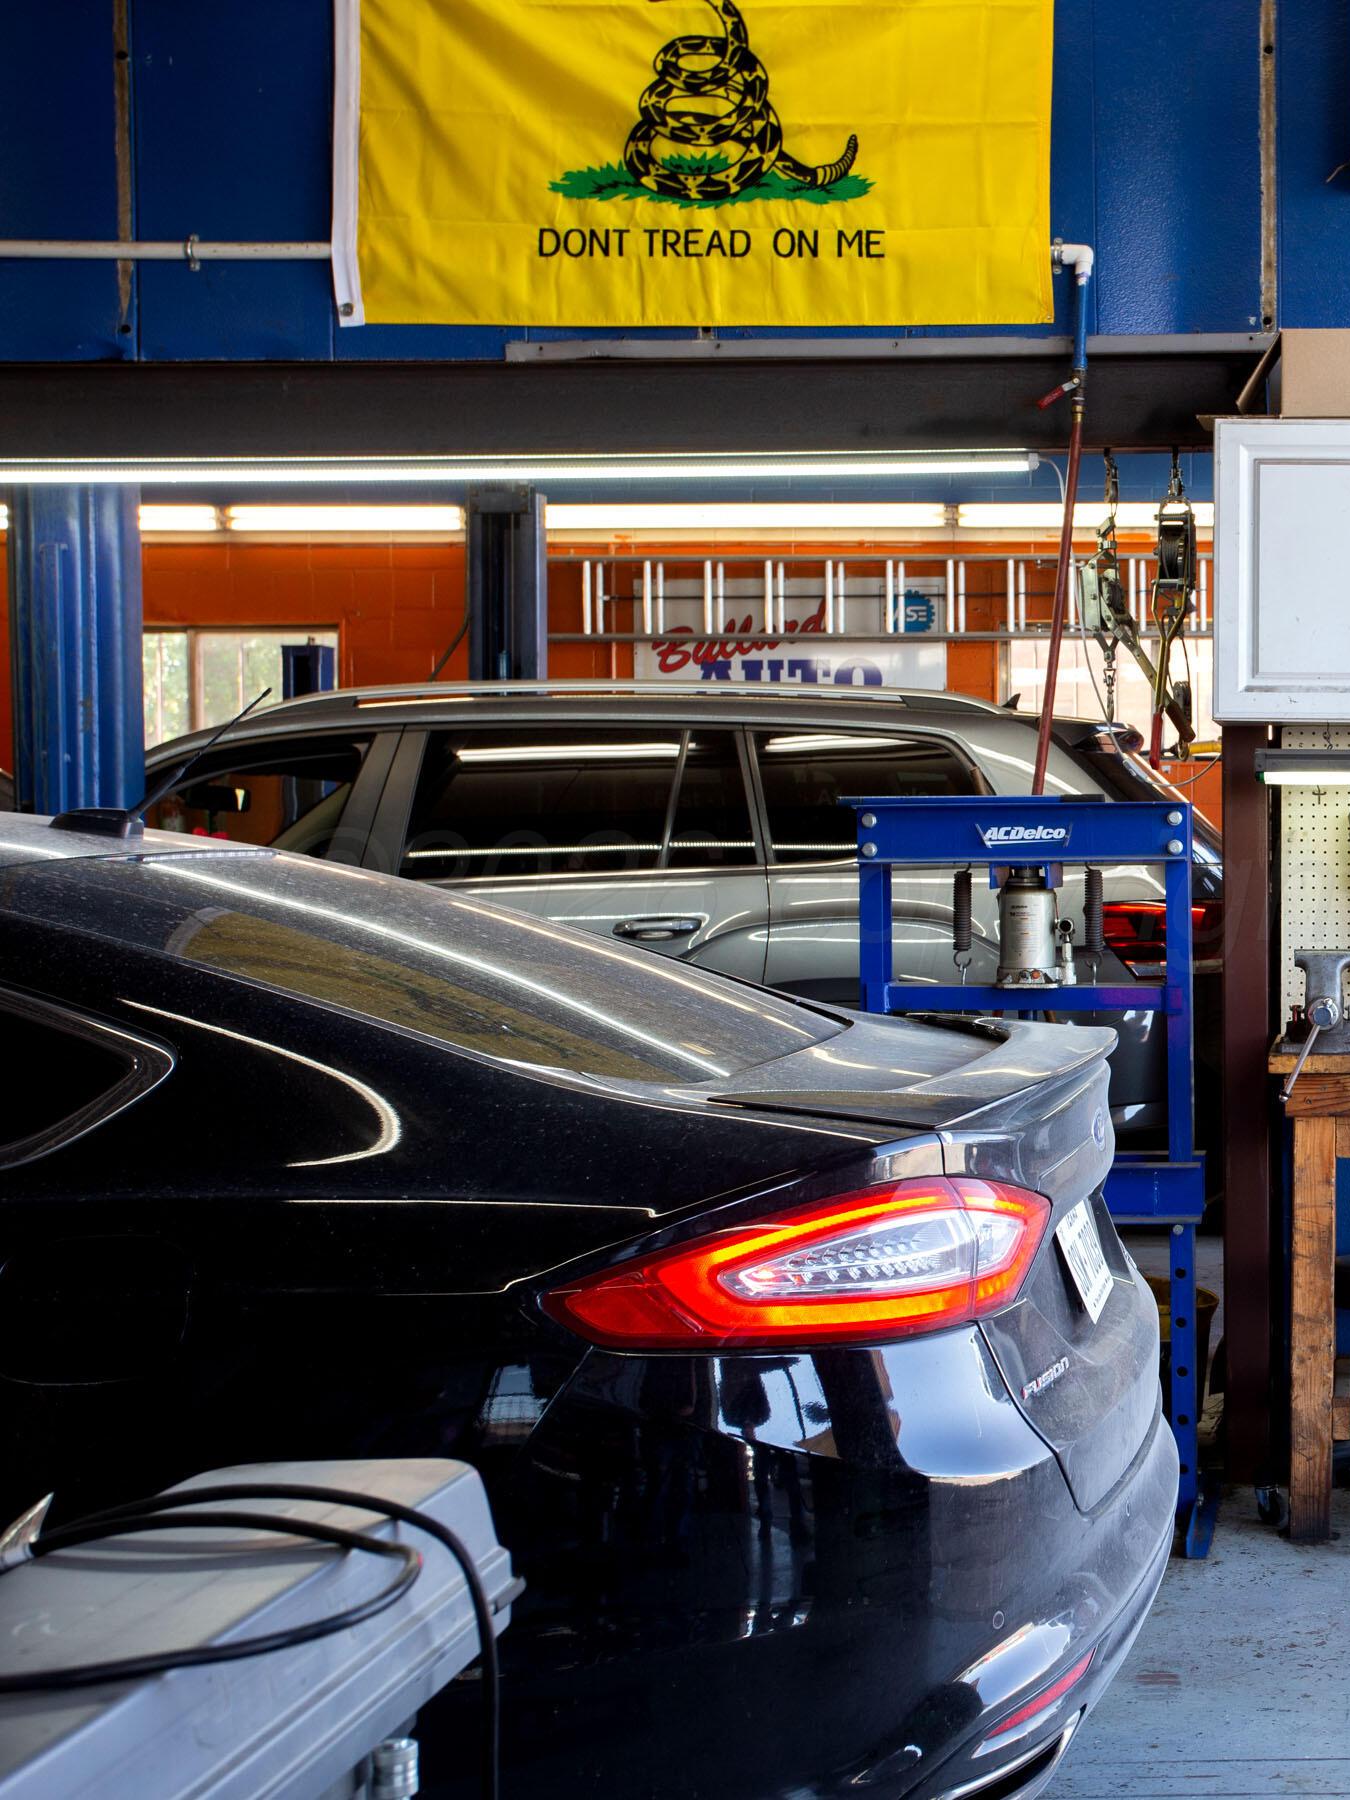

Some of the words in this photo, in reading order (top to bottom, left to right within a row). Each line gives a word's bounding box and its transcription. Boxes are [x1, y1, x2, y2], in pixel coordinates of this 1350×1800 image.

[538, 228, 629, 258] DONT
[643, 228, 751, 258] TREAD
[772, 228, 821, 258] ON
[838, 228, 886, 258] ME
[984, 825, 1067, 840] ACDelco
[1021, 1356, 1070, 1400] FUSION
